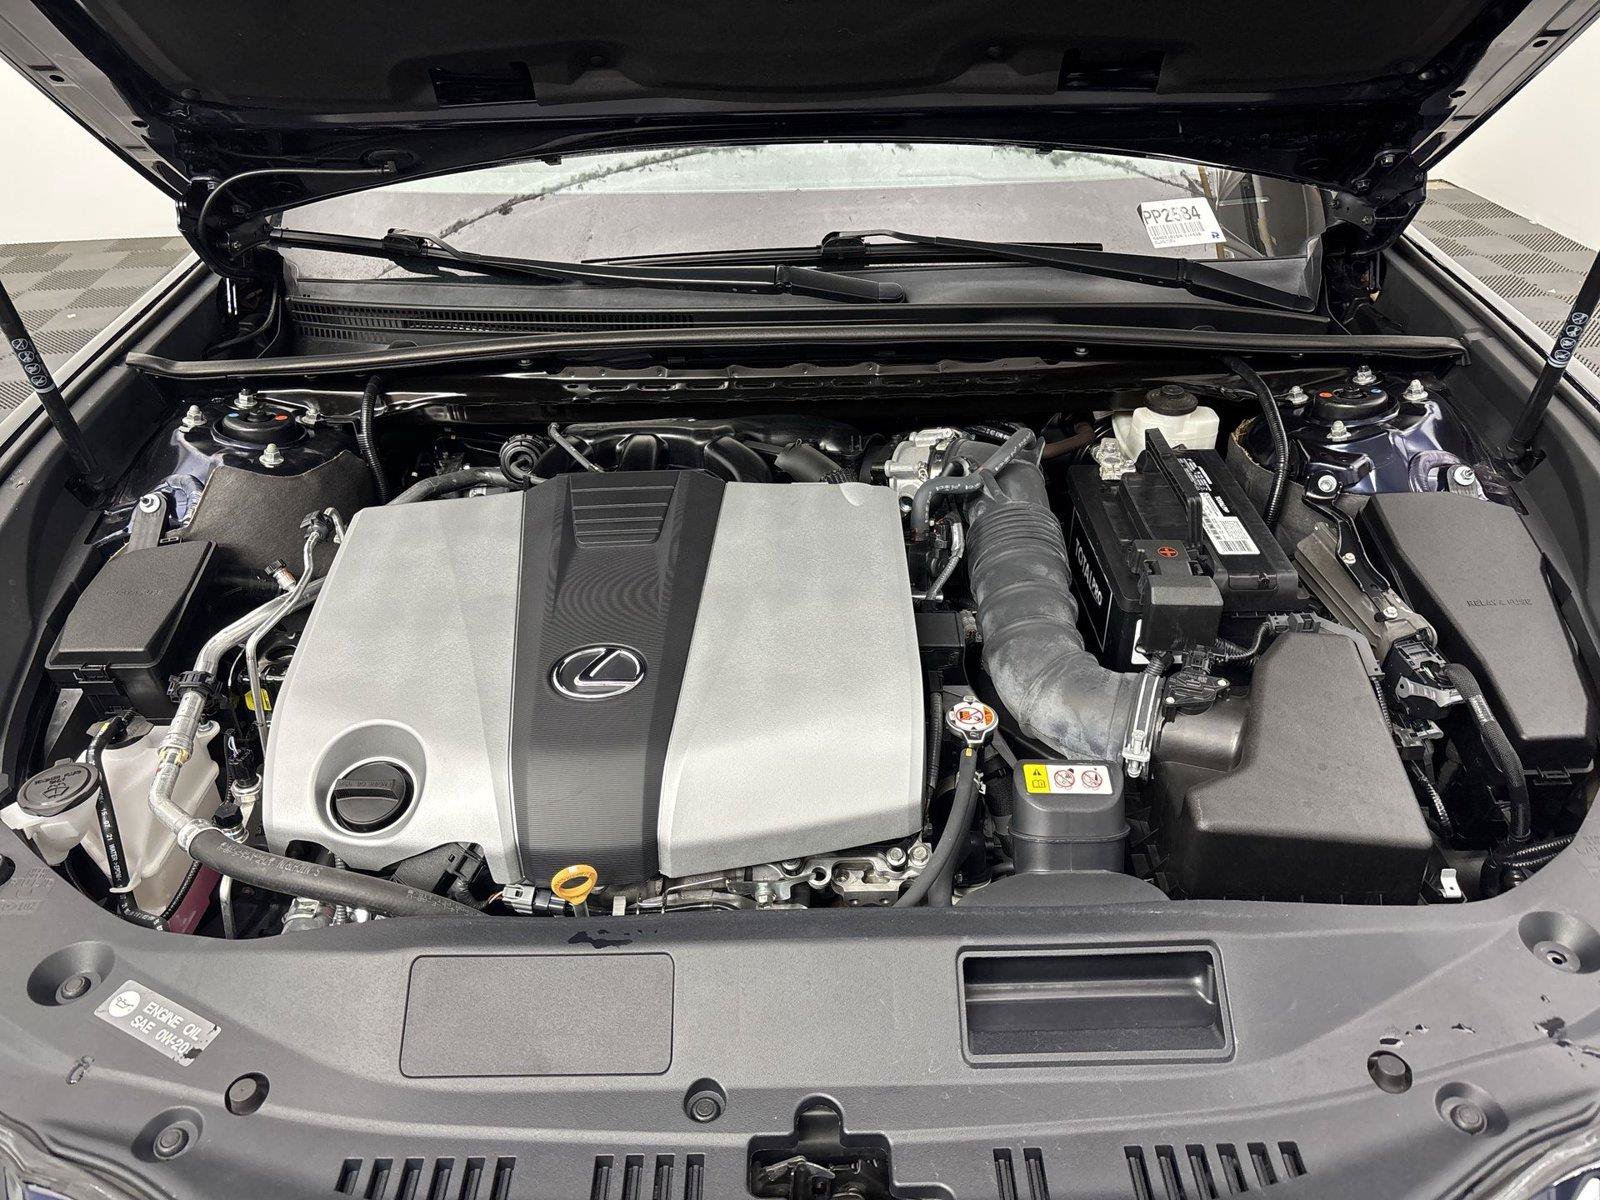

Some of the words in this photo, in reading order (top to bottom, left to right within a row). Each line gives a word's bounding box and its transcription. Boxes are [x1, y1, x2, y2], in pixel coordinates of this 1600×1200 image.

[130, 1015, 156, 1034] SAE
[143, 1001, 184, 1029] ENGINE
[182, 1023, 202, 1041] OIL
